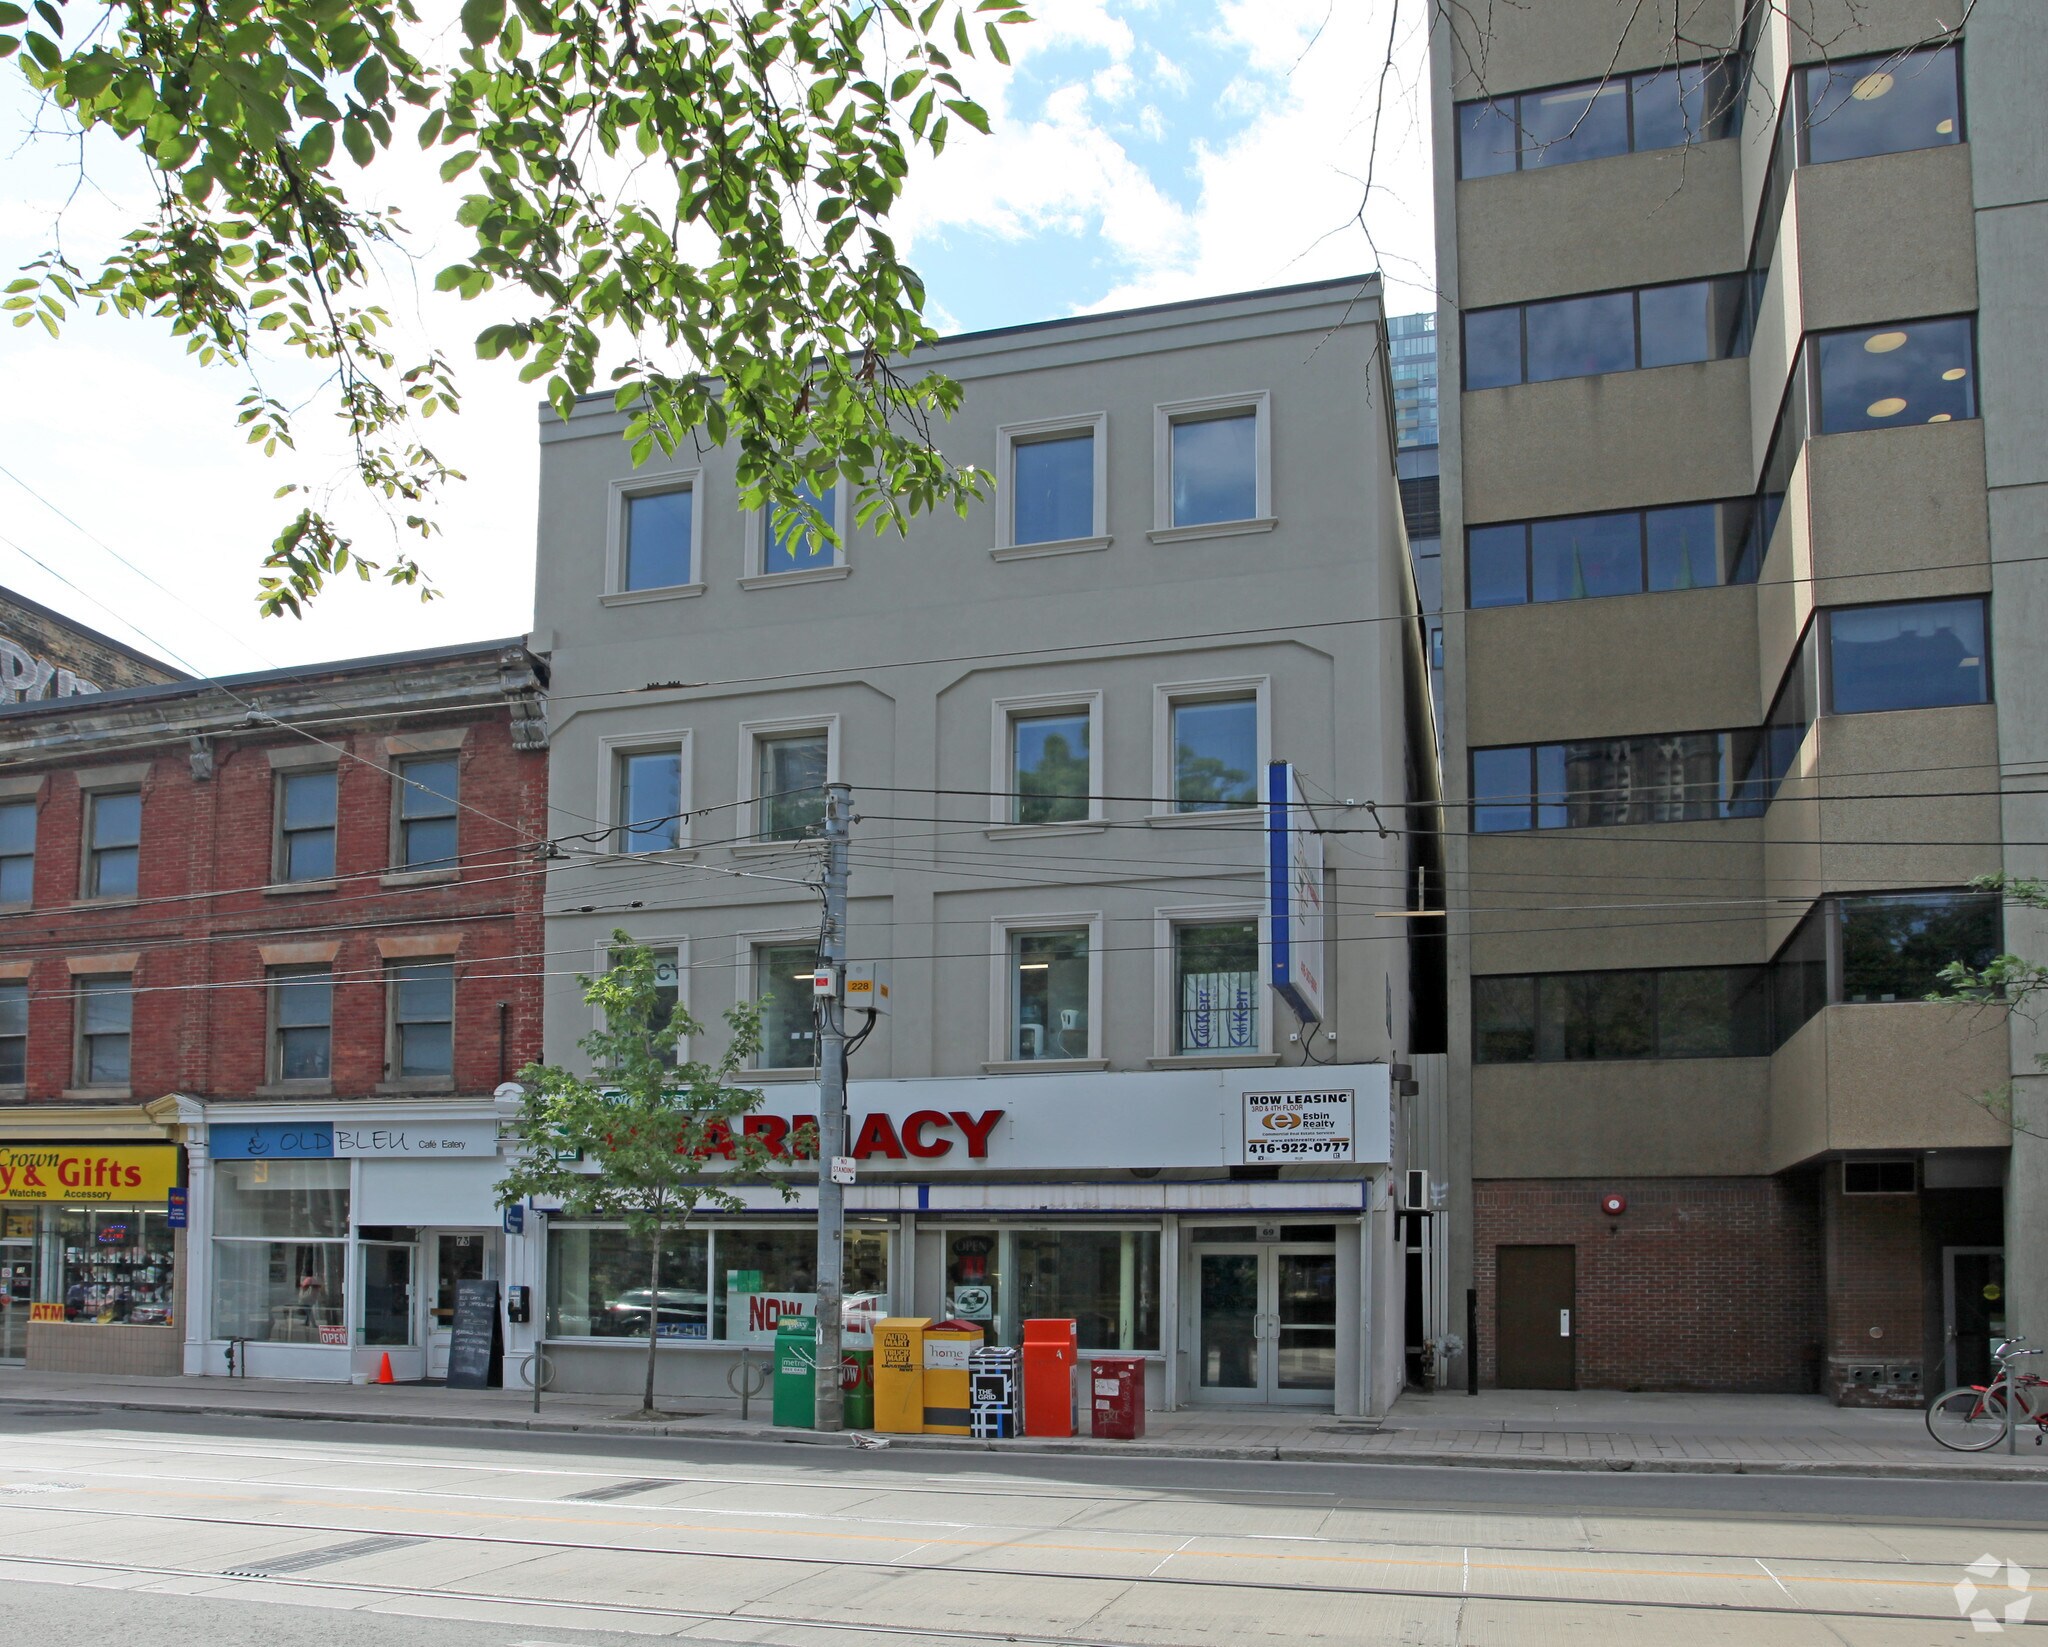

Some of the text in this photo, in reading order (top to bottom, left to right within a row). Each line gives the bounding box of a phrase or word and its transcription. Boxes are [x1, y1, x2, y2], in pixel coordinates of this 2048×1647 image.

[851, 982, 869, 991] 228
[1232, 988, 1248, 1022] Kerr
[1250, 1094, 1347, 1105] NOW LEASING
[1303, 1112, 1330, 1120] Esbin
[1303, 1120, 1335, 1128] Realty
[280, 1132, 331, 1150] OLD
[418, 1139, 466, 1150] Café Eatery
[1249, 1142, 1350, 1154] 416-922-0777
[0, 1148, 60, 1168] Crown
[23, 1164, 47, 1187] &
[57, 1157, 142, 1188] Gifts
[832, 1166, 855, 1174] STANDING
[9, 1189, 112, 1200] Watches Accessory
[1262, 1228, 1274, 1236] 69
[457, 1236, 469, 1245] 73
[956, 1240, 987, 1251] OPEN
[33, 1304, 64, 1321] ATM
[322, 1333, 347, 1344] OPEN
[886, 1333, 908, 1341] AUTO
[930, 1344, 963, 1357] home
[783, 1359, 806, 1367] metro
